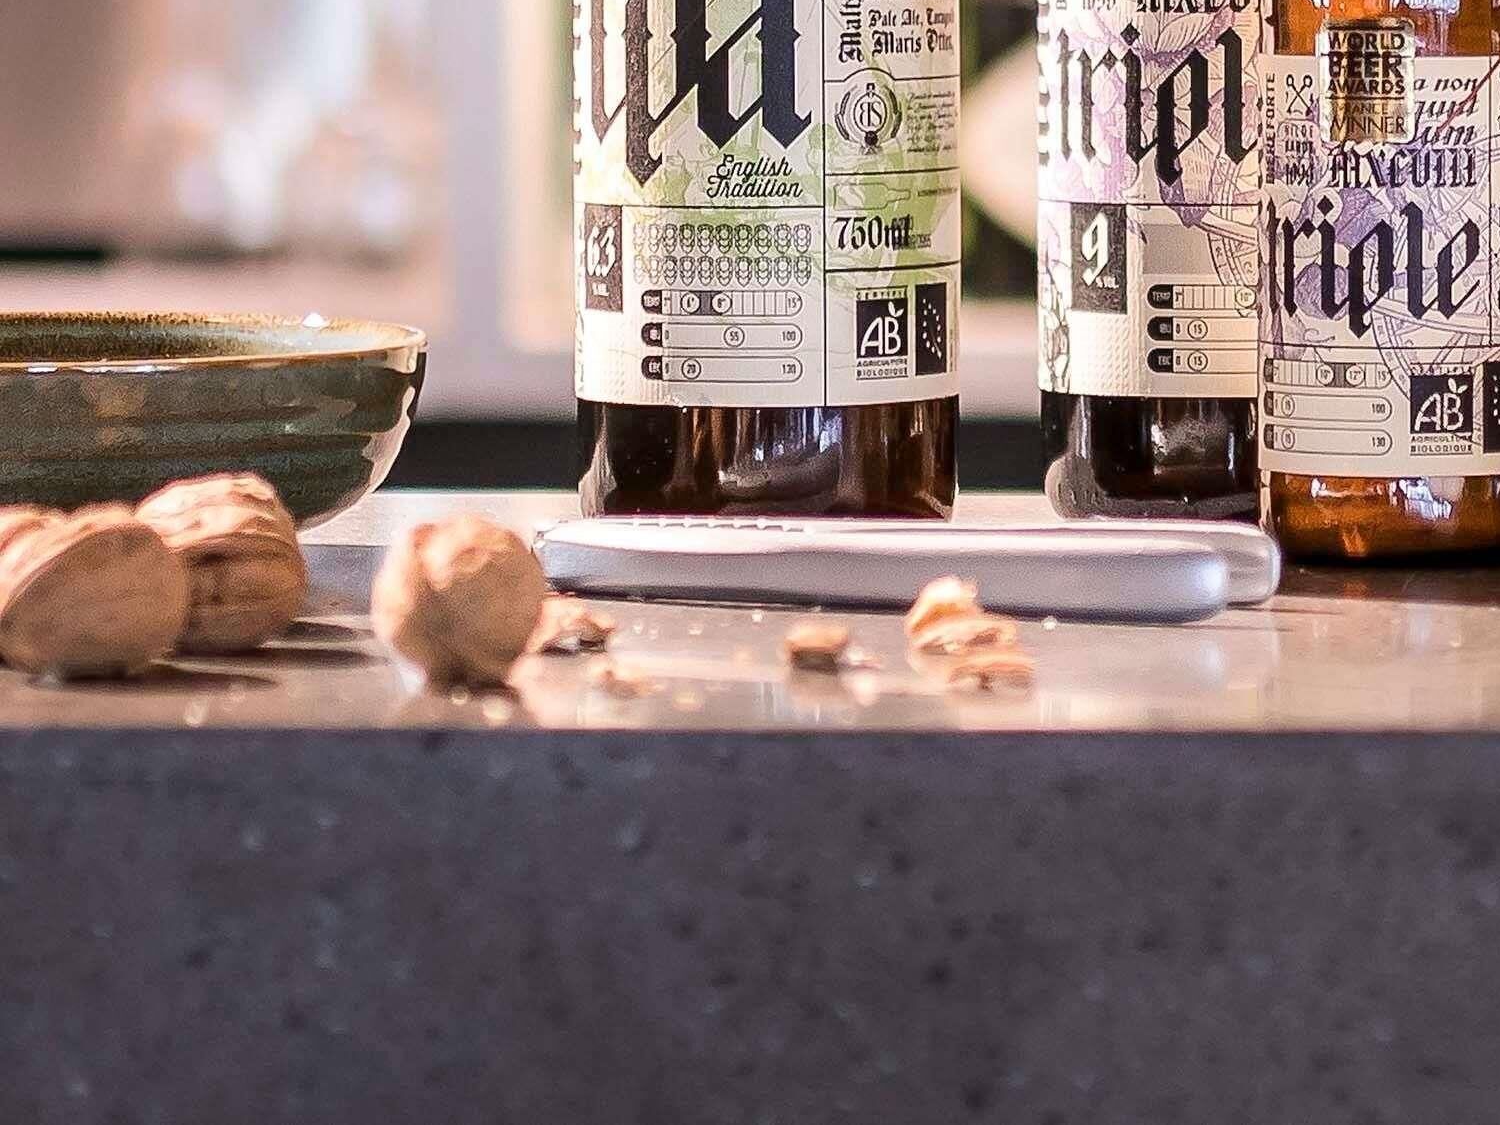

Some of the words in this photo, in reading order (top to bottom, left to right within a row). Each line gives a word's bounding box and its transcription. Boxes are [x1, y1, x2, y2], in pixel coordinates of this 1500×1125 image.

[1328, 32, 1406, 50] WORLD
[1328, 51, 1404, 78] BEER
[1328, 79, 1406, 94] AWARDS
[1331, 116, 1408, 135] WINNER
[716, 153, 793, 183] English
[706, 175, 803, 198] Tradition
[861, 315, 901, 356] AB
[1371, 403, 1386, 414] 100
[1414, 392, 1464, 432] AB
